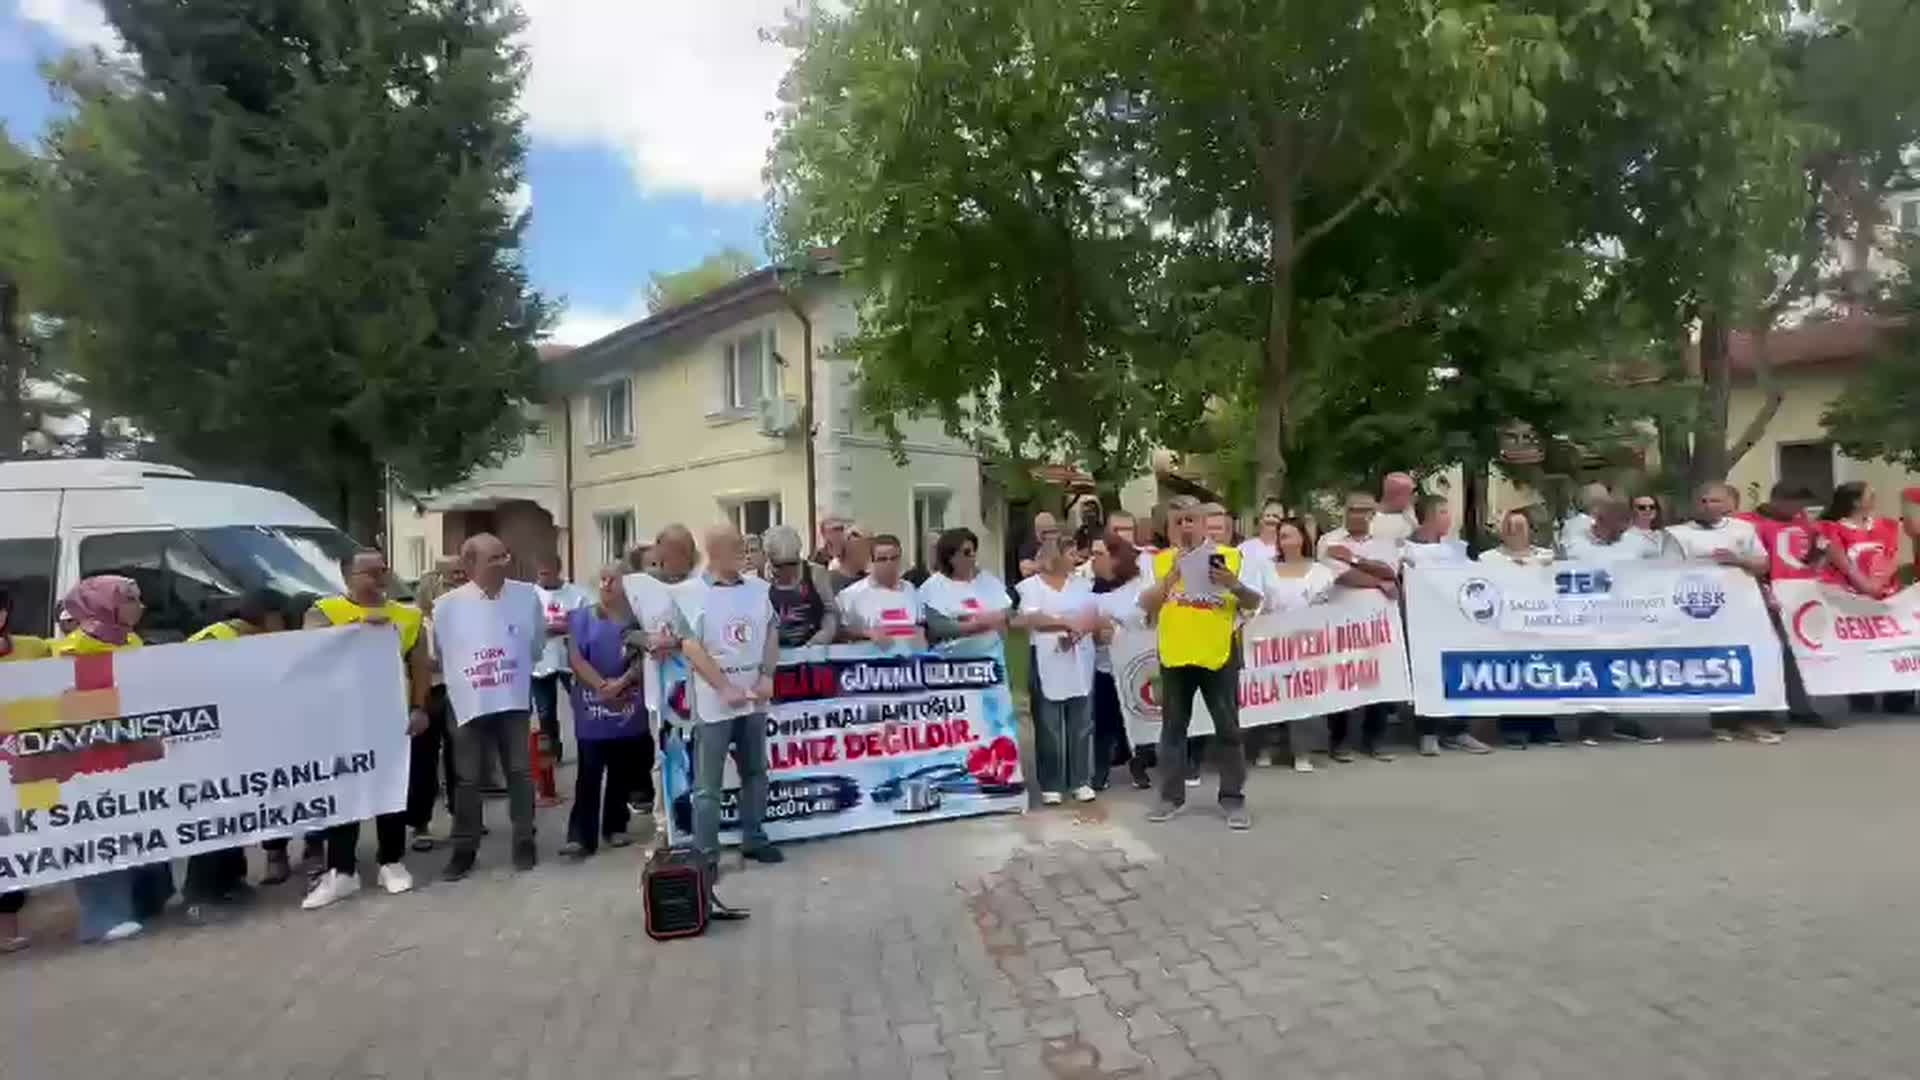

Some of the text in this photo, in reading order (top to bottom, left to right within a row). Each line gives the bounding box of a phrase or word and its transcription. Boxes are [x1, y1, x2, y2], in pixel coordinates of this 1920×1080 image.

[1458, 654, 1599, 692] MUĞLA
[48, 787, 170, 828] SAĞLIK
[178, 749, 375, 811] ÇALIŞANLARI
